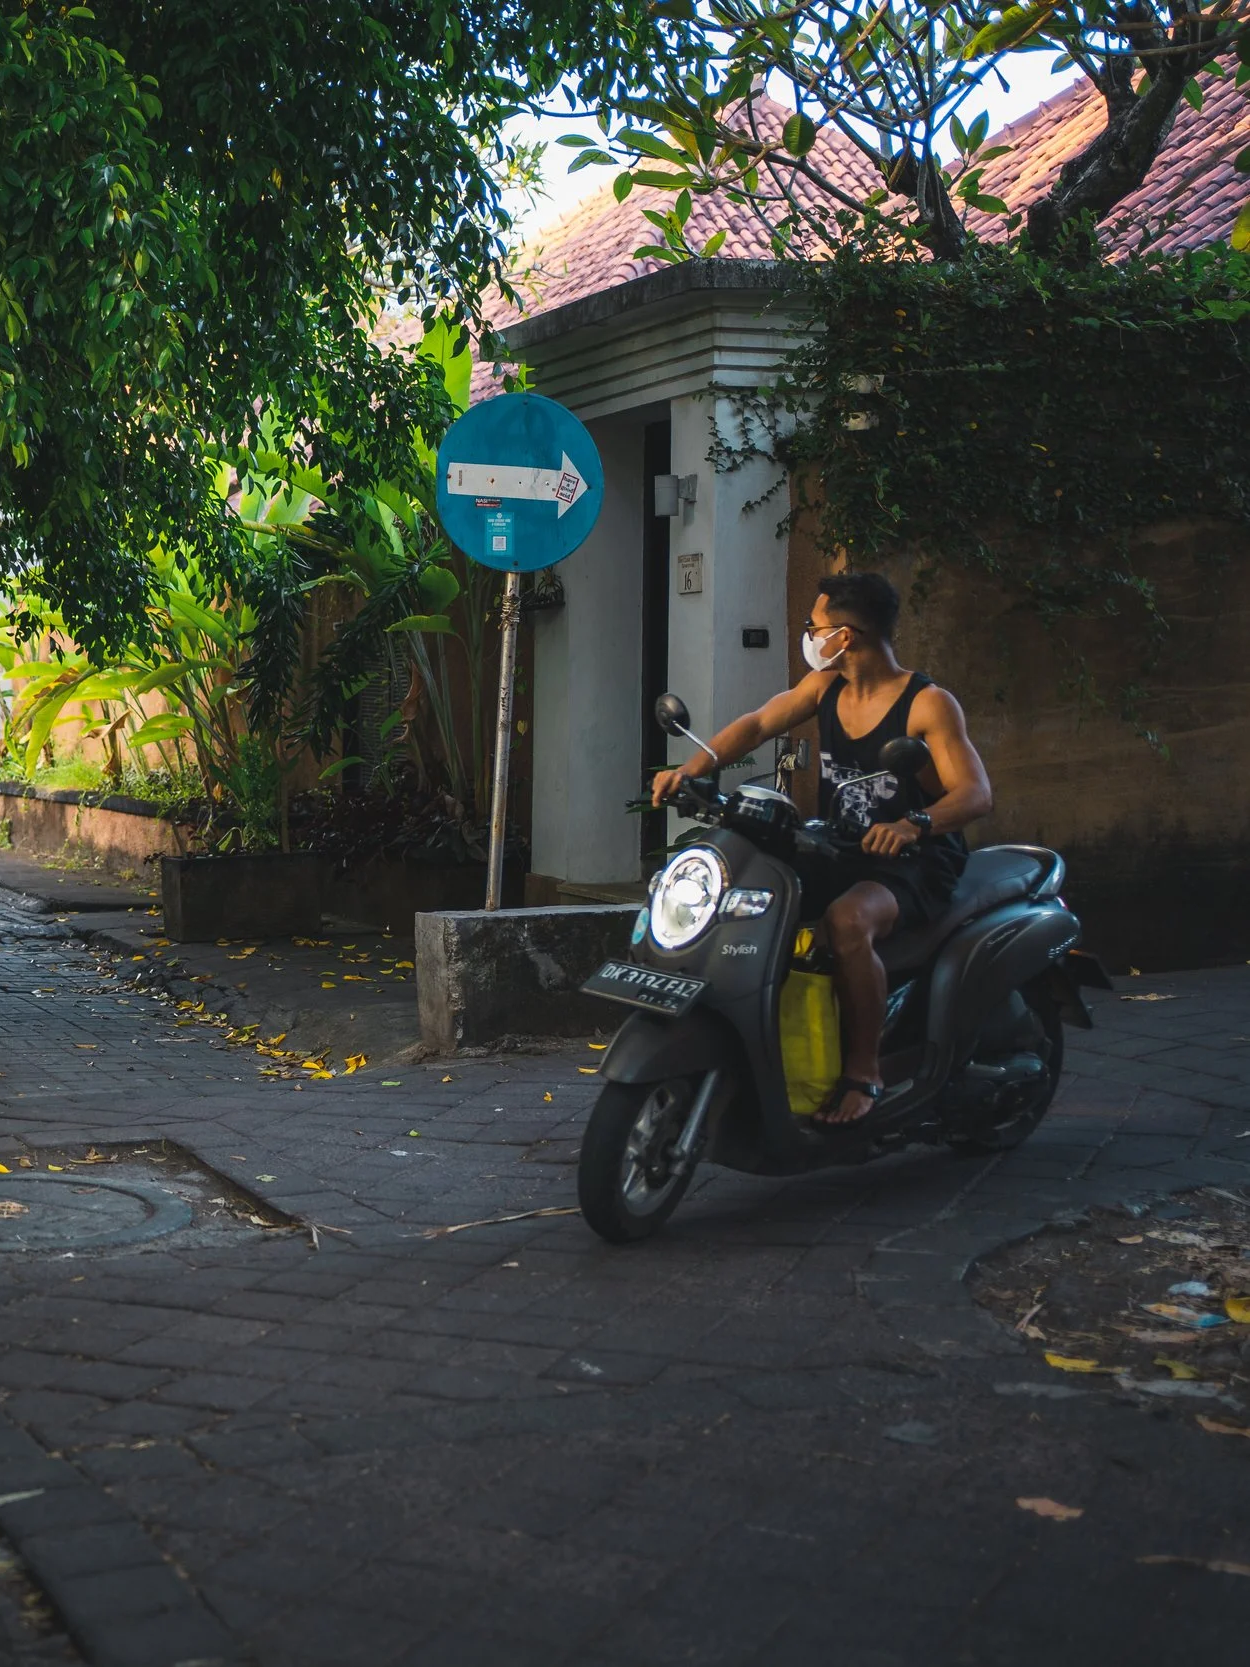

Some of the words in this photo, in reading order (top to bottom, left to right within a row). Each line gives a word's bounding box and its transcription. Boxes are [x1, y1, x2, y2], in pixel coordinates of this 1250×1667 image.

[684, 571, 692, 590] 16
[721, 944, 758, 956] Stylish
[601, 963, 627, 980] DK
[664, 979, 698, 997] FAZ
